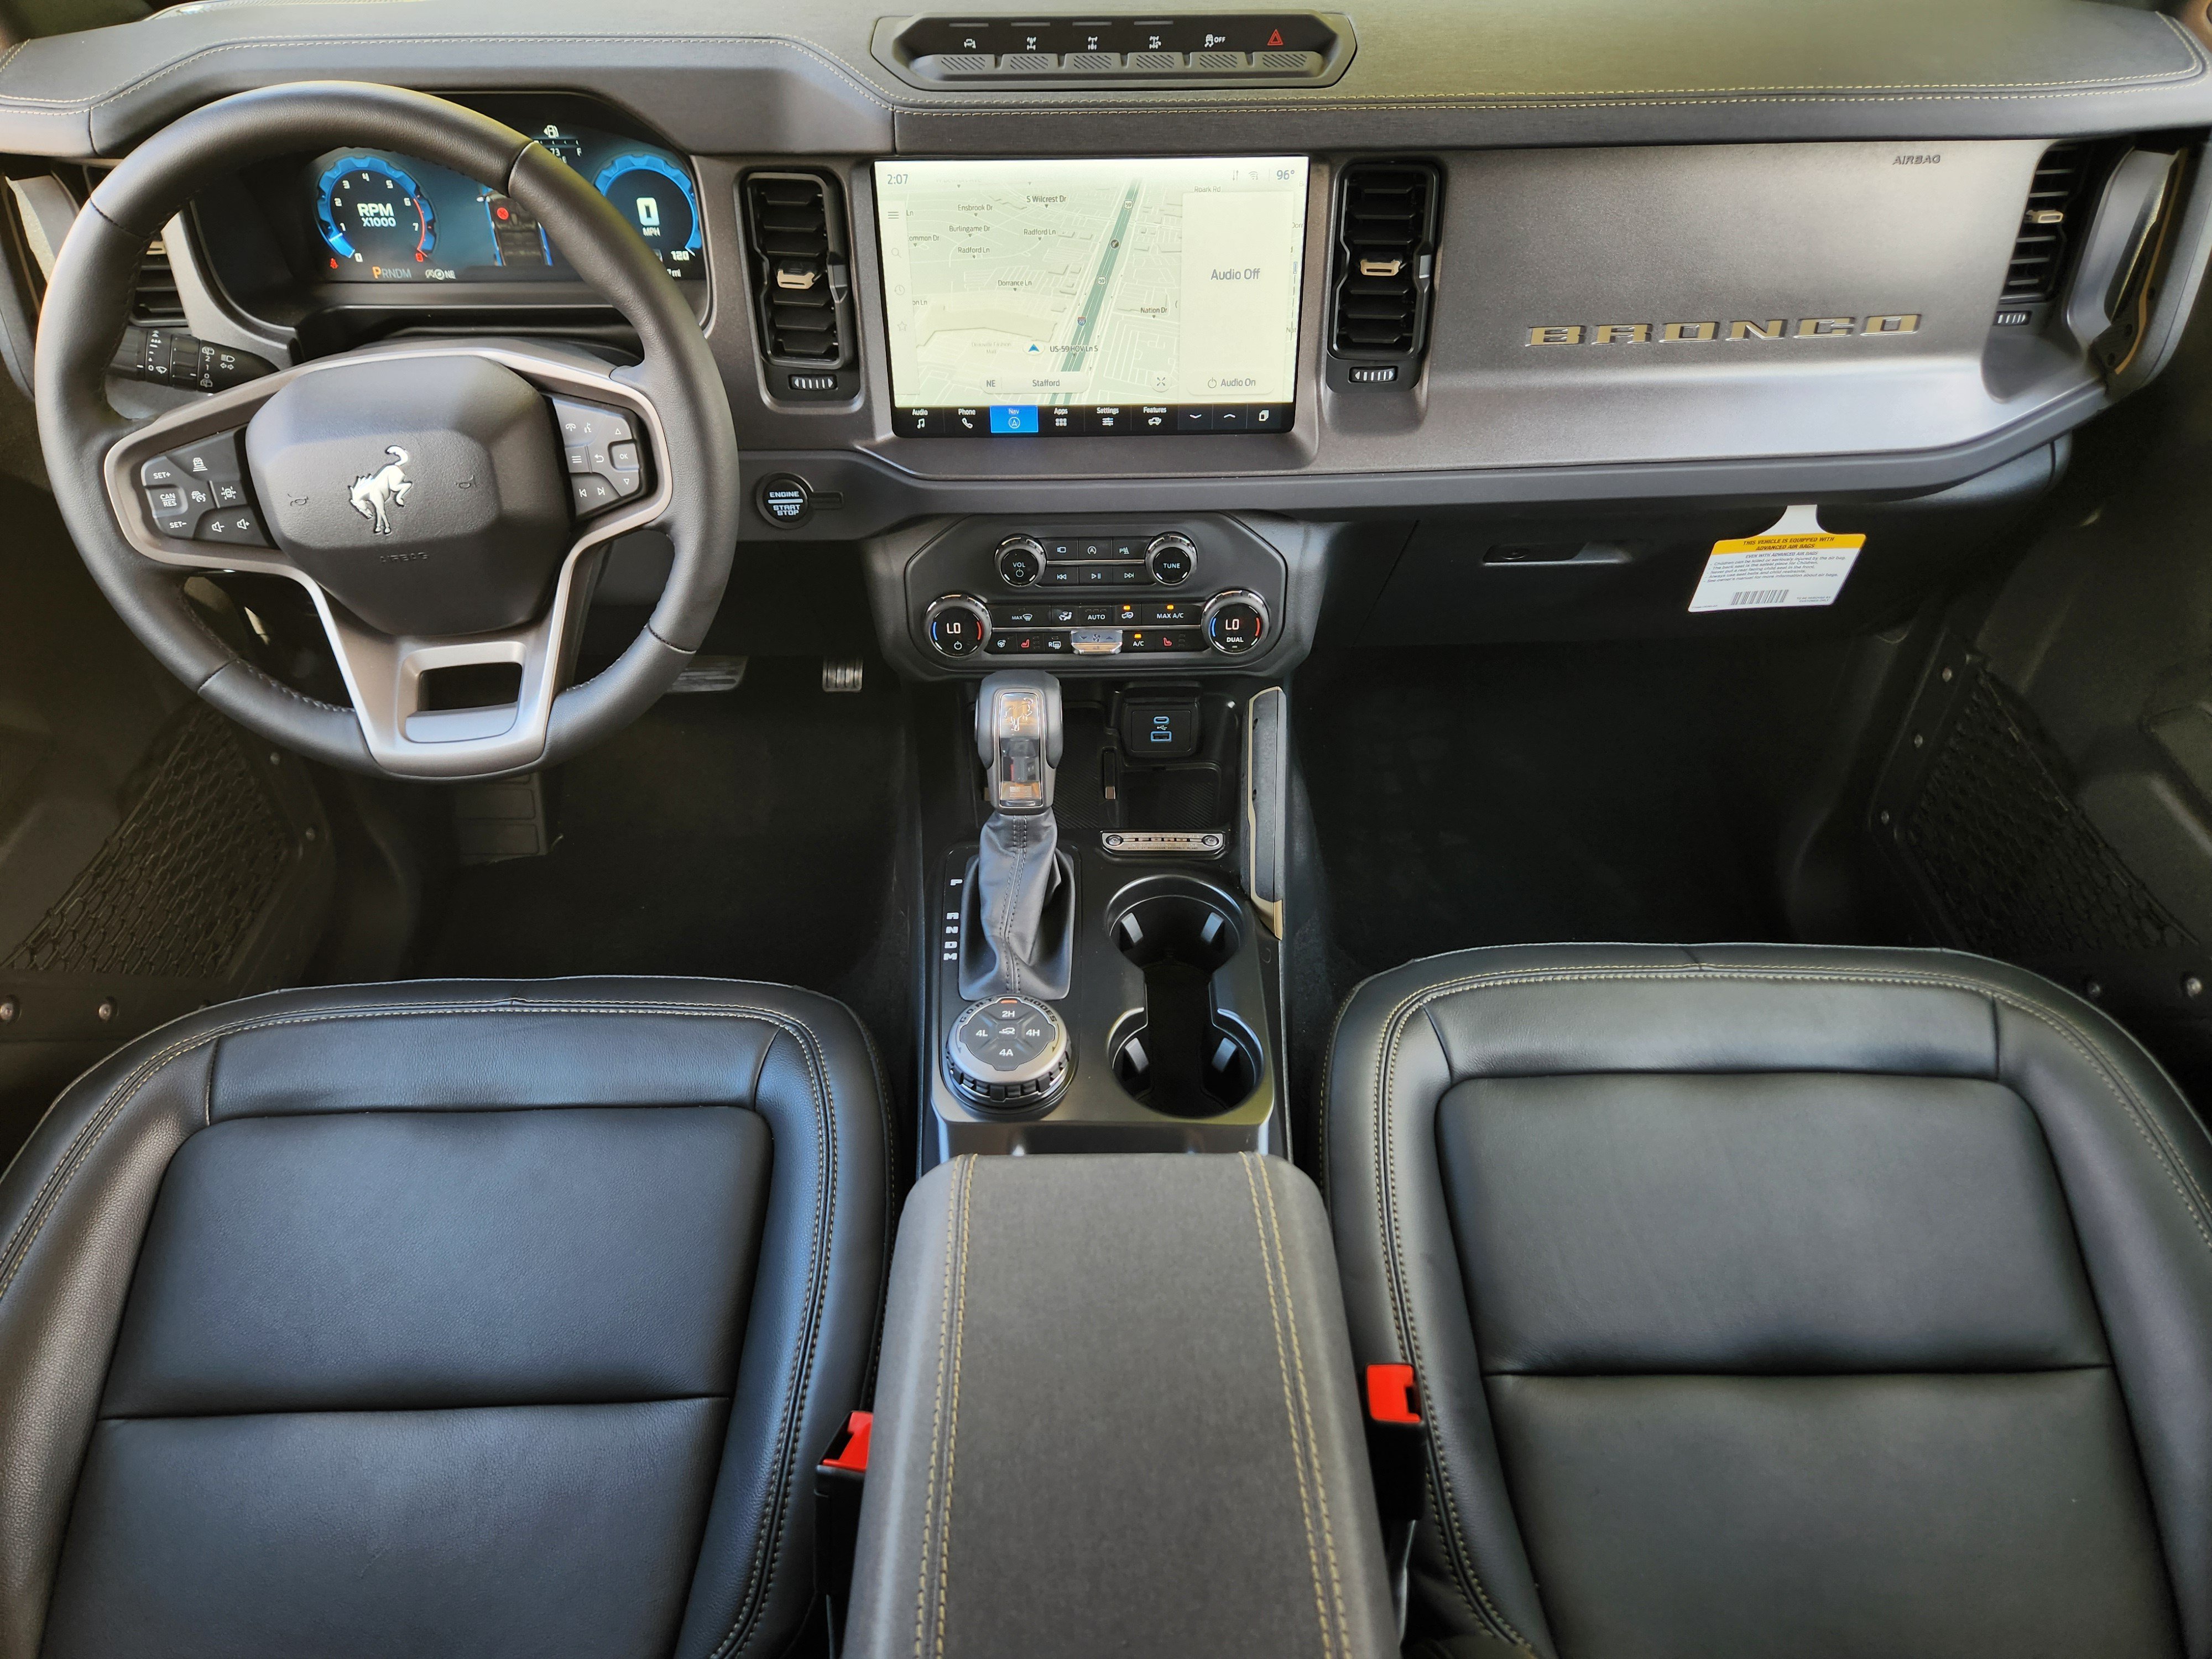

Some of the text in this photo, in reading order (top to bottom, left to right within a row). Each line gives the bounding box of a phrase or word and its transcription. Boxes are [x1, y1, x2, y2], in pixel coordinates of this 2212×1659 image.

[1892, 154, 1940, 165] AIRBAG
[362, 173, 370, 181] 4
[887, 174, 908, 185] 2:07
[1276, 170, 1295, 180] 96°
[342, 180, 350, 189] 3
[385, 180, 393, 189] 5
[334, 197, 342, 206] 2
[403, 197, 411, 206] 6
[357, 203, 395, 217] RPM
[636, 197, 660, 226] 0
[340, 222, 346, 232] 1
[361, 217, 397, 227] X1000
[413, 222, 419, 232] 7
[643, 227, 661, 237] MPH
[354, 253, 363, 262] 0
[671, 251, 690, 261] 120
[1211, 268, 1261, 280] Audio Off
[1525, 314, 1922, 347] BRONCO
[946, 623, 961, 634] LO
[1225, 619, 1239, 630] LO
[1024, 997, 1057, 1022] MODES
